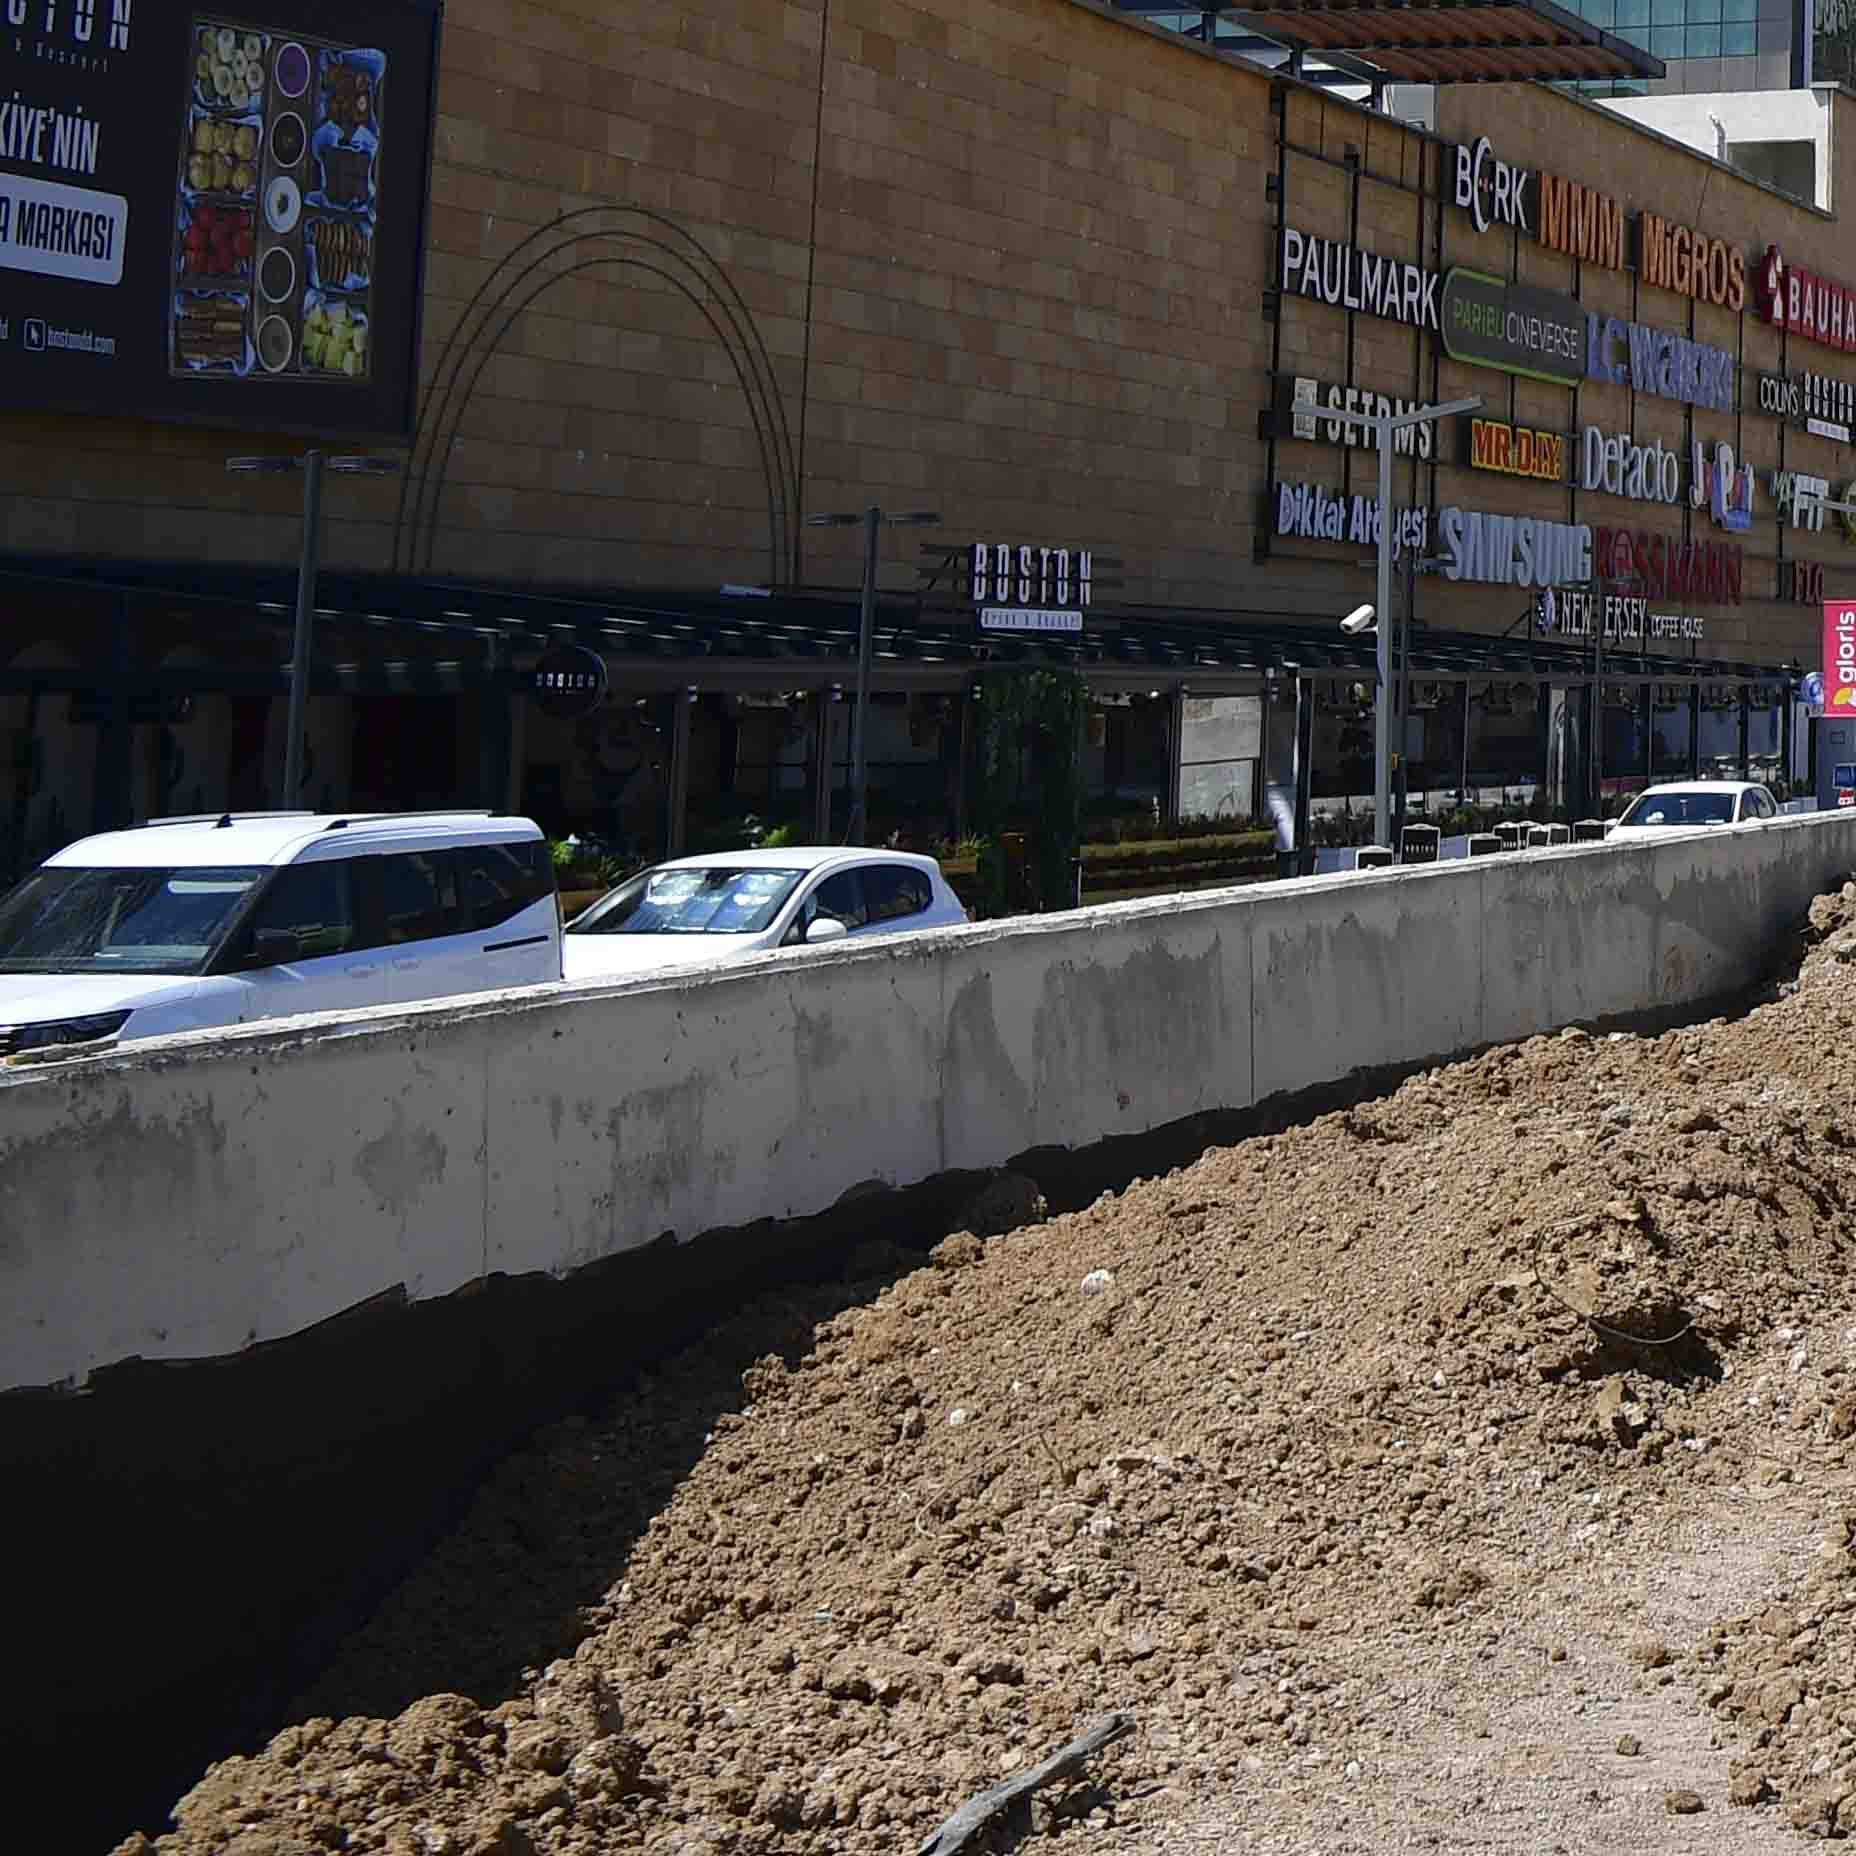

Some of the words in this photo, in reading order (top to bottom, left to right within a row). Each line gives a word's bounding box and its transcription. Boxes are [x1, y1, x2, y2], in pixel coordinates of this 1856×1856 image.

[16, 199, 115, 261] MARKASI
[1282, 227, 1439, 331] PAULMARK
[1453, 297, 1505, 340] PARIBU
[1506, 310, 1578, 360] CINEVERSE
[1804, 371, 1854, 424] BOSTON
[1582, 424, 1680, 505] DeFacto
[1278, 481, 1346, 540] Dikkat
[1349, 495, 1428, 560] Atöyesi
[1439, 505, 1592, 588] SAMSUNG
[973, 543, 1092, 606] BOSTON
[1560, 591, 1593, 637] NEW
[1592, 596, 1647, 644] ERSEY
